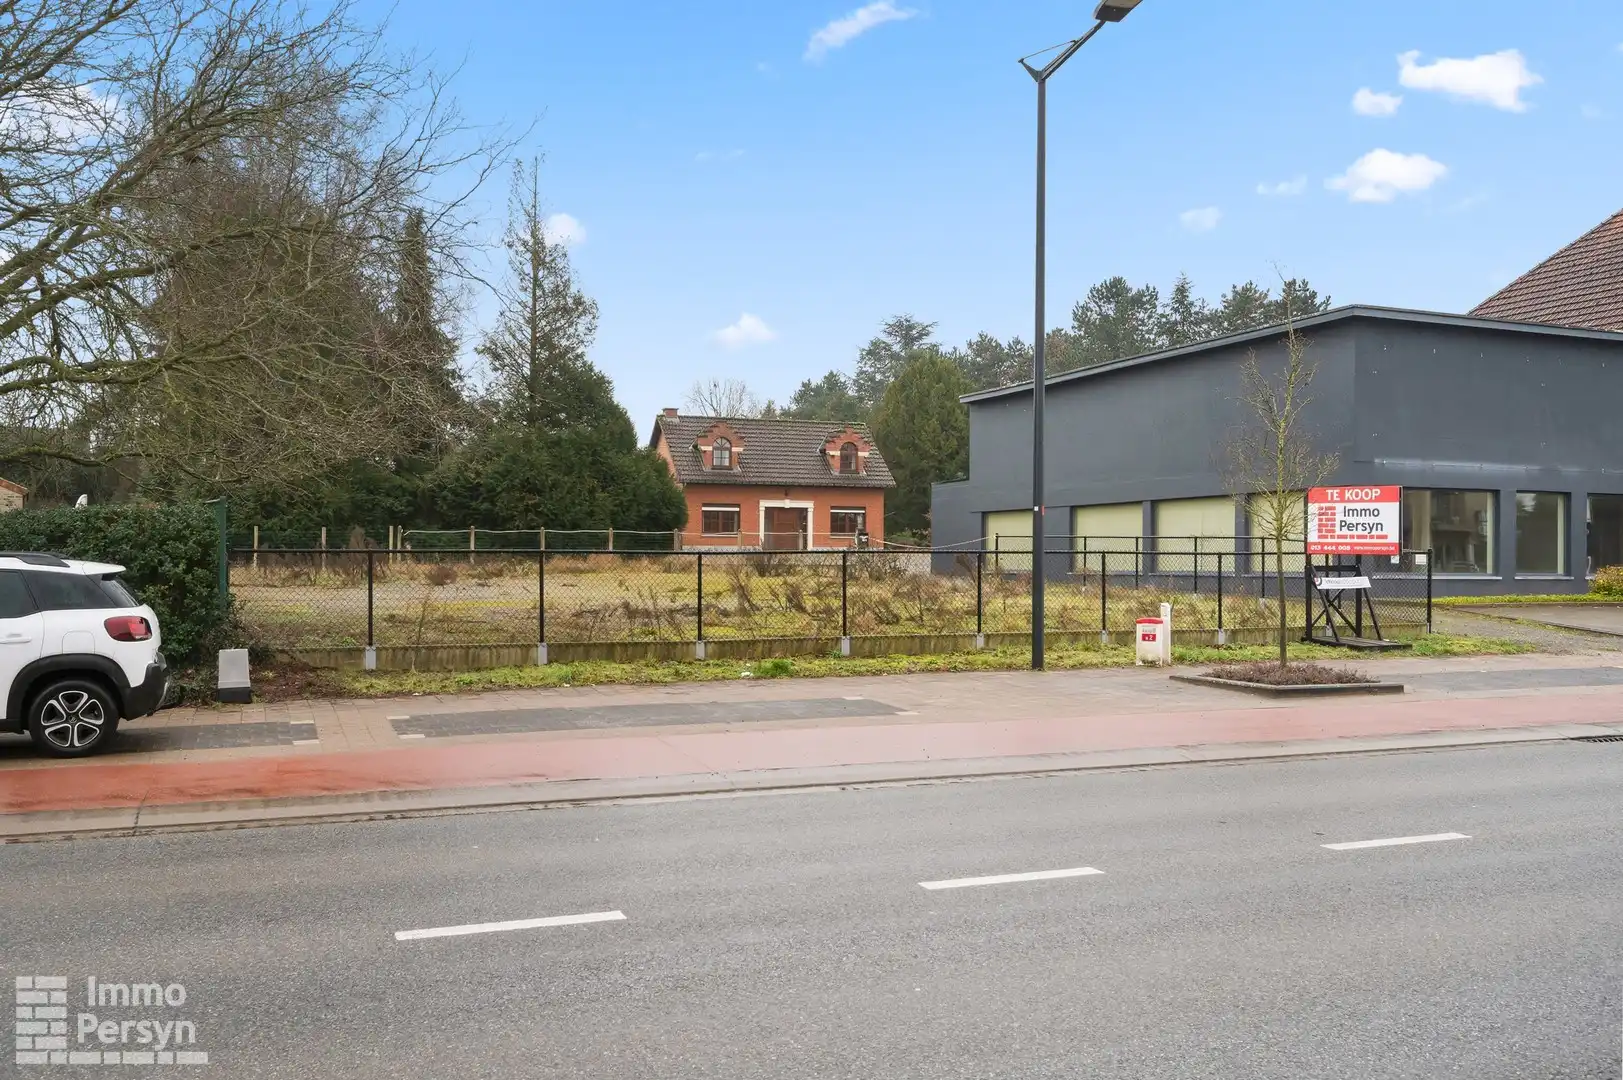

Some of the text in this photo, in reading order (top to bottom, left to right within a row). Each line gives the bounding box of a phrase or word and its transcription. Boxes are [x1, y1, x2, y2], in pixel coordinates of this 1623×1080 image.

[1326, 488, 1381, 501] TE KOOP
[1343, 506, 1380, 518] Immo
[1339, 520, 1384, 534] Persyn
